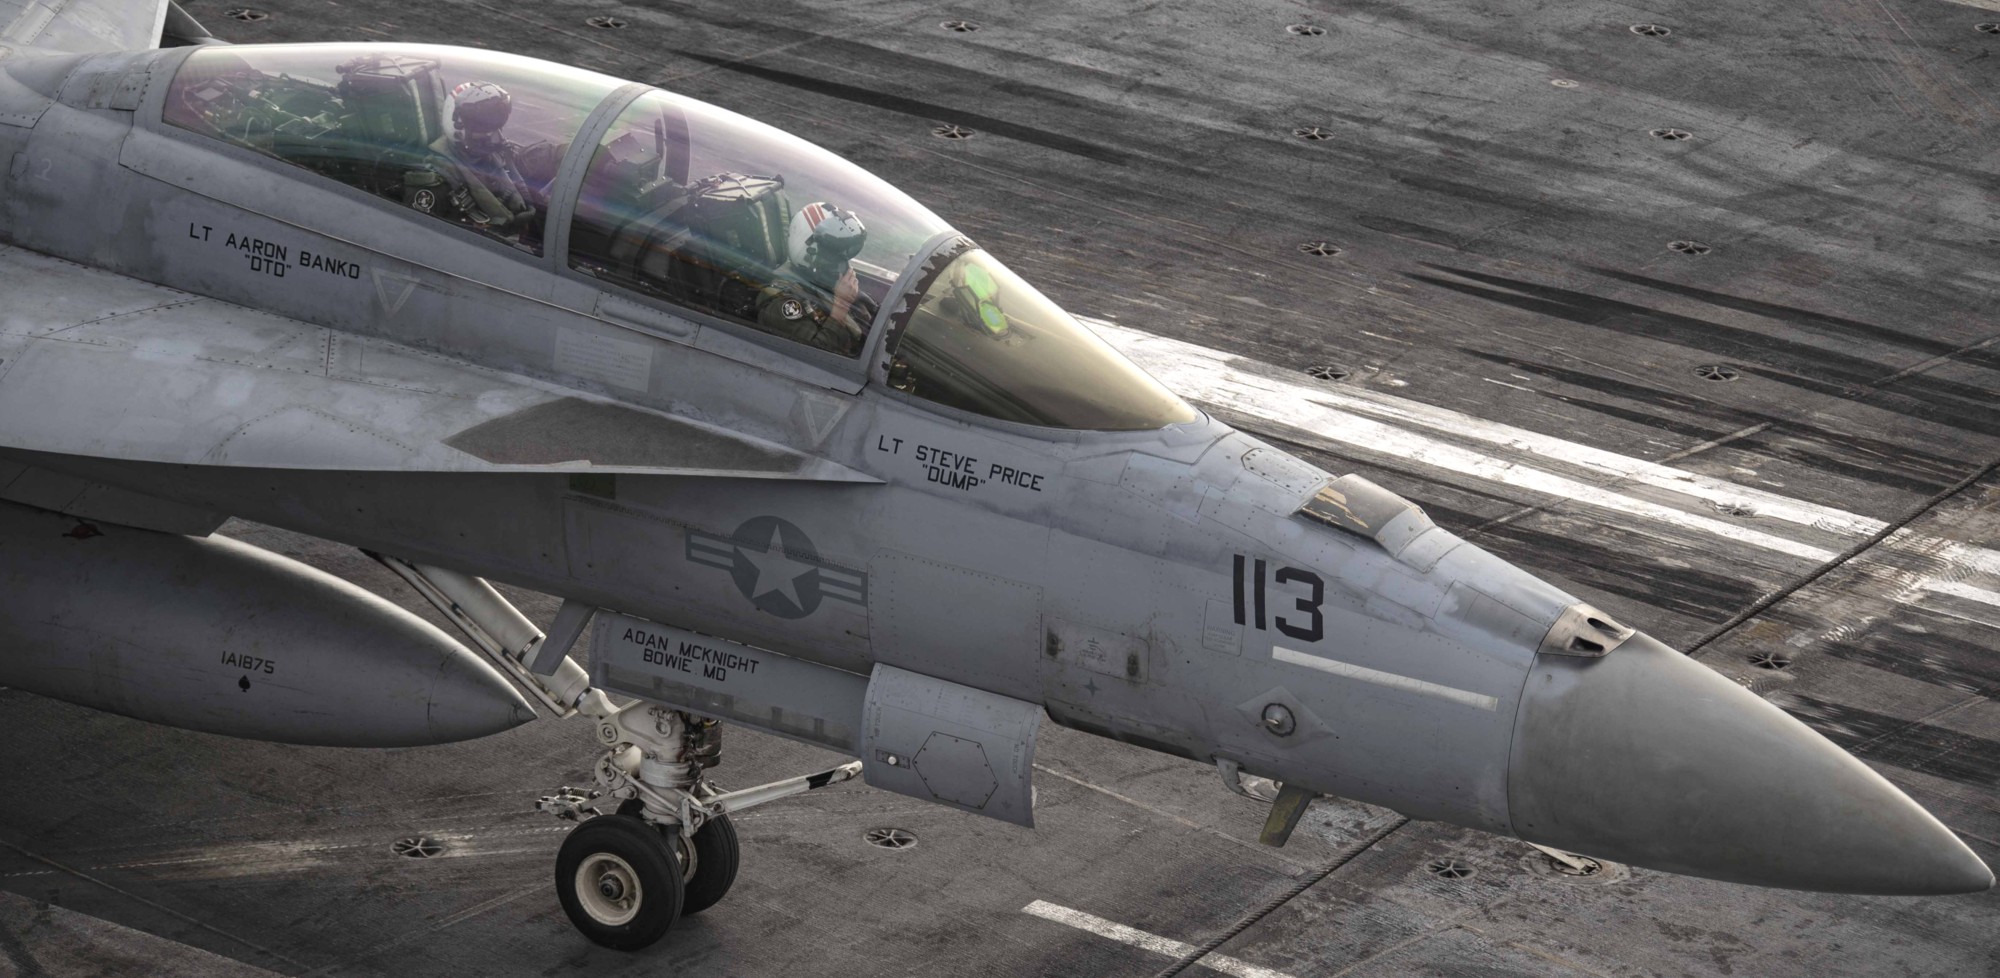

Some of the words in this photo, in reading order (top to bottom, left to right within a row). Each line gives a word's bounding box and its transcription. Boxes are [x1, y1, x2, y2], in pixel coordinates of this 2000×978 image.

[189, 222, 213, 241] LT
[225, 233, 287, 261] AARON
[299, 251, 360, 280] BANKO
[878, 434, 903, 454] LT
[915, 445, 977, 475] STEVE
[989, 463, 1044, 492] PRICE
[922, 463, 986, 491] "DUMP"
[1233, 553, 1324, 643] 113
[643, 648, 693, 673] BOWIE
[703, 664, 726, 682] MD
[679, 641, 759, 674] MCKNIGHT
